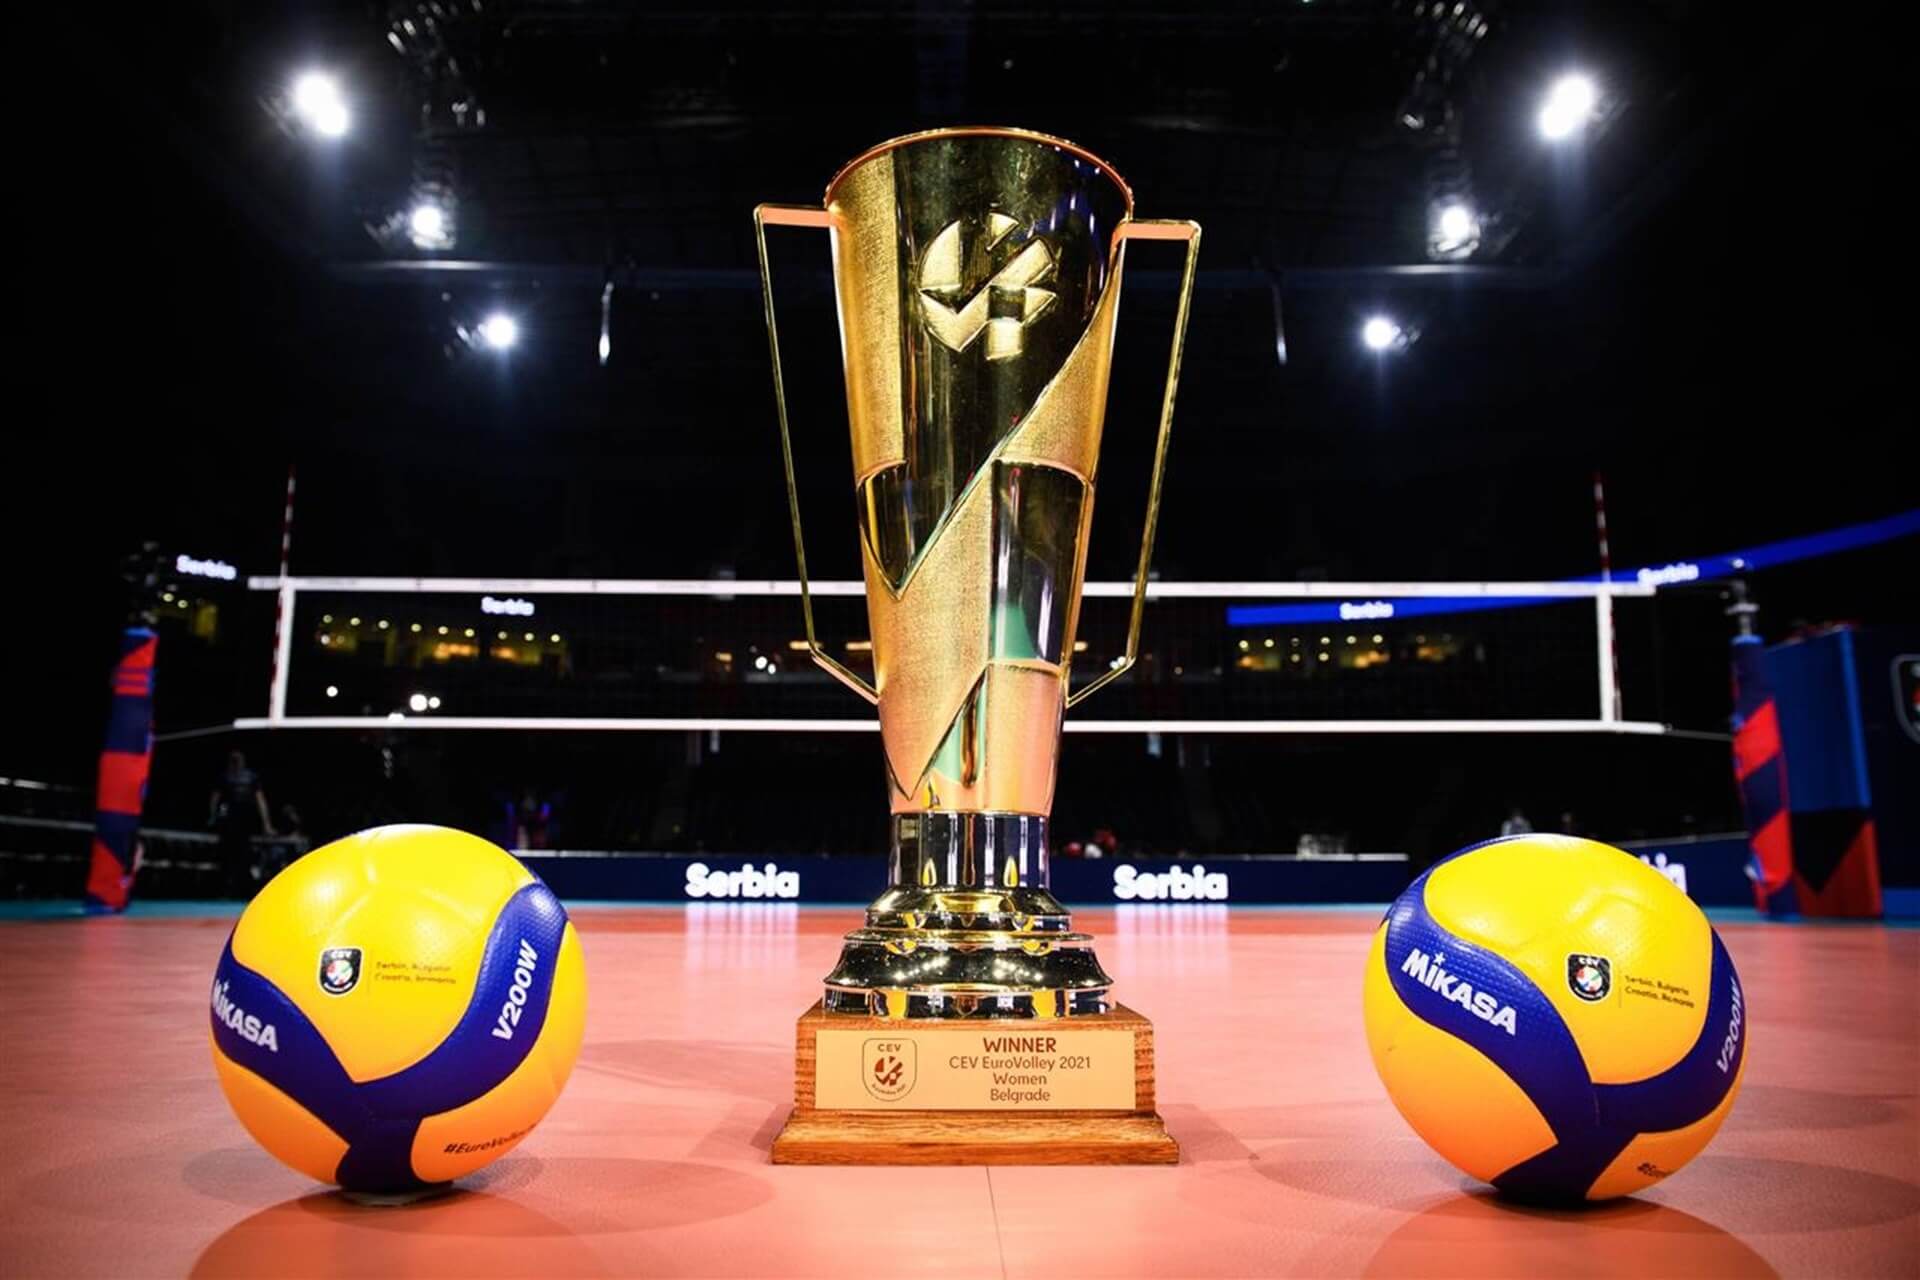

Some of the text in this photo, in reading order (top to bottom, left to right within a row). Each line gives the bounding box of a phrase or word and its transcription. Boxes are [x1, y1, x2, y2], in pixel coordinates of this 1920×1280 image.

[685, 863, 800, 898] Serbia
[1113, 864, 1229, 899] Serbia
[492, 938, 538, 1040] V200W
[1401, 948, 1516, 1036] MIKASA
[877, 1043, 902, 1053] CEV
[983, 1037, 1057, 1053] WINNER
[949, 1055, 1091, 1072] CEV EuroVolley 2021
[993, 1072, 1048, 1085] Women
[990, 1087, 1051, 1104] Belgrade
